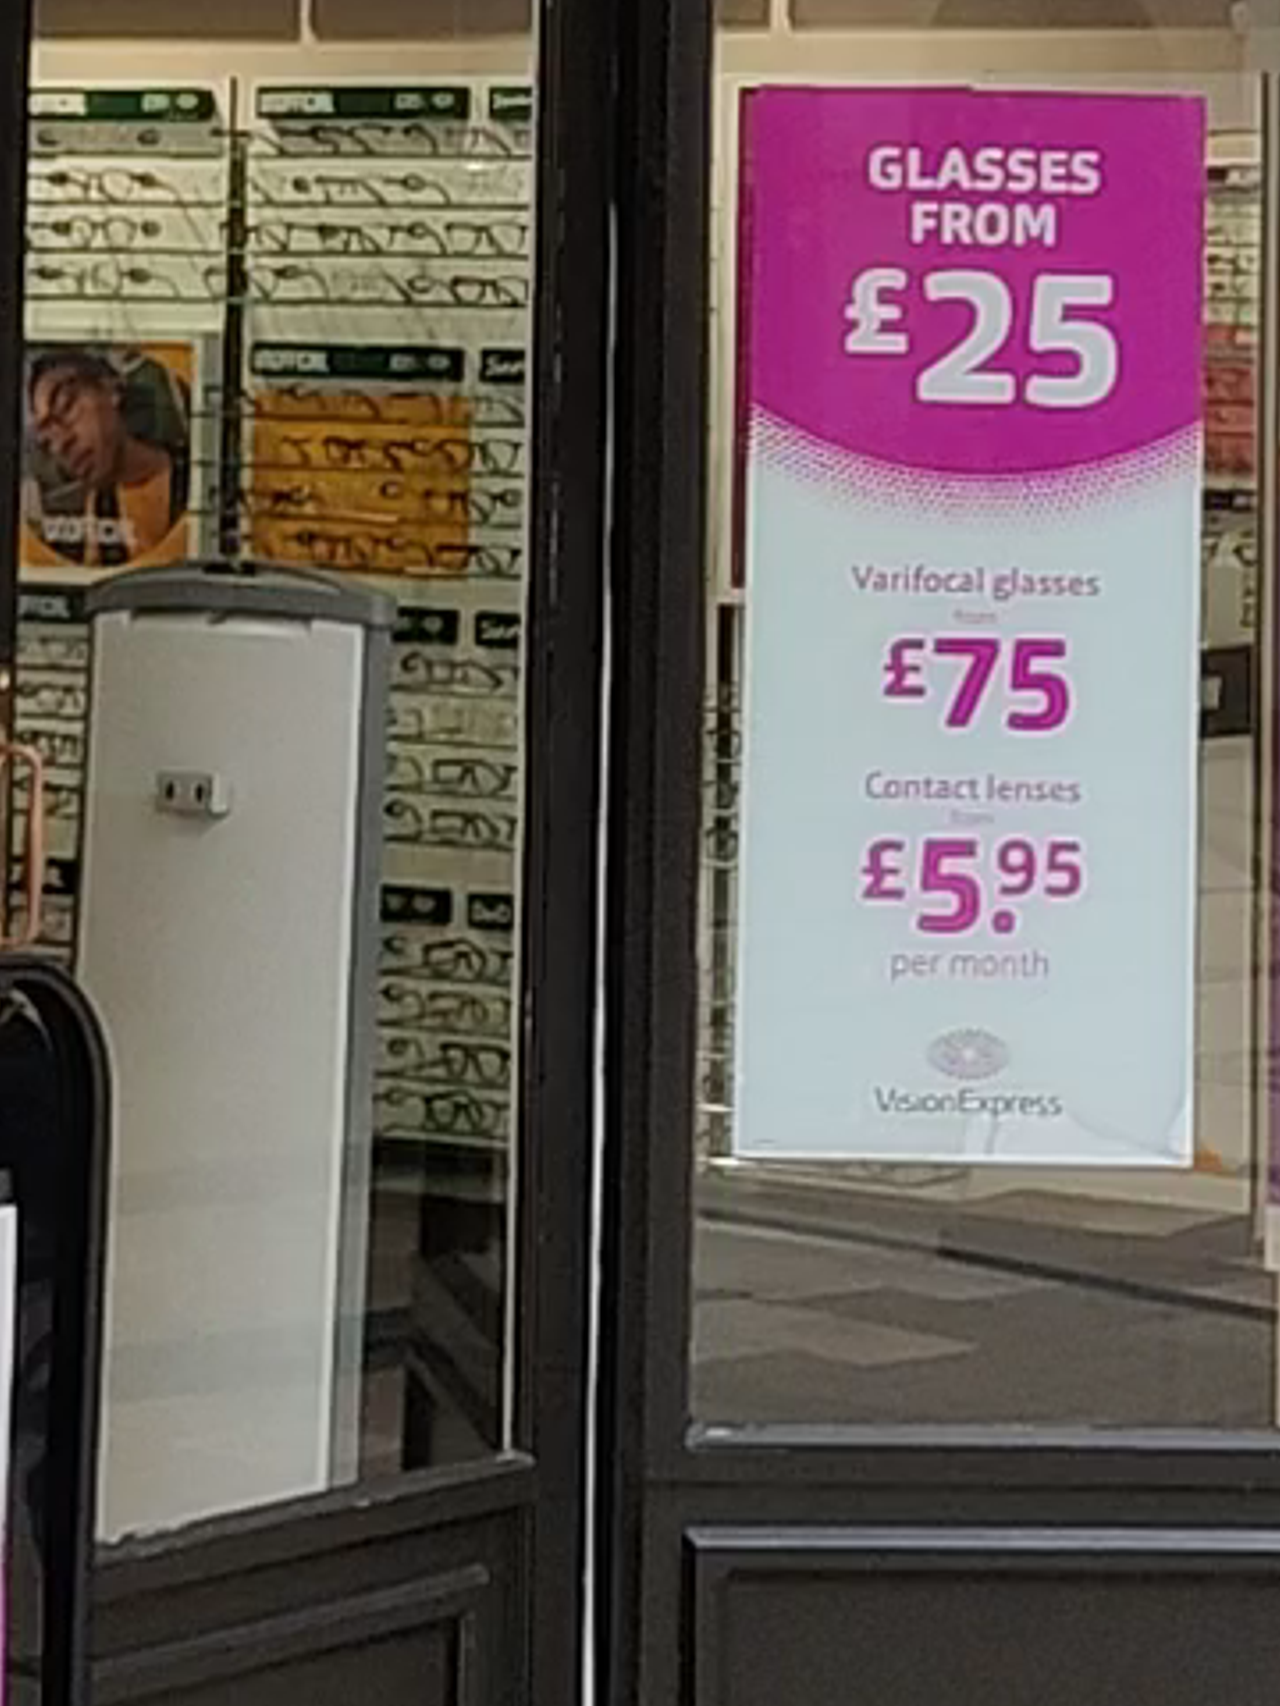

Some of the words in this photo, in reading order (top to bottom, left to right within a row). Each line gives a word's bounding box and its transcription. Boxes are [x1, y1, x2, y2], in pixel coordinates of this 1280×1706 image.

[868, 146, 1102, 196] GLASSES
[911, 201, 1057, 247] FROM
[844, 267, 1118, 408] £25
[851, 563, 985, 595] Varifocal
[991, 564, 1101, 602] glasses
[882, 638, 1070, 732] £75
[864, 770, 980, 801] Contact
[985, 773, 1082, 804] lenses
[860, 839, 1082, 934] £5.95
[890, 952, 942, 983] per
[949, 948, 1050, 979] month
